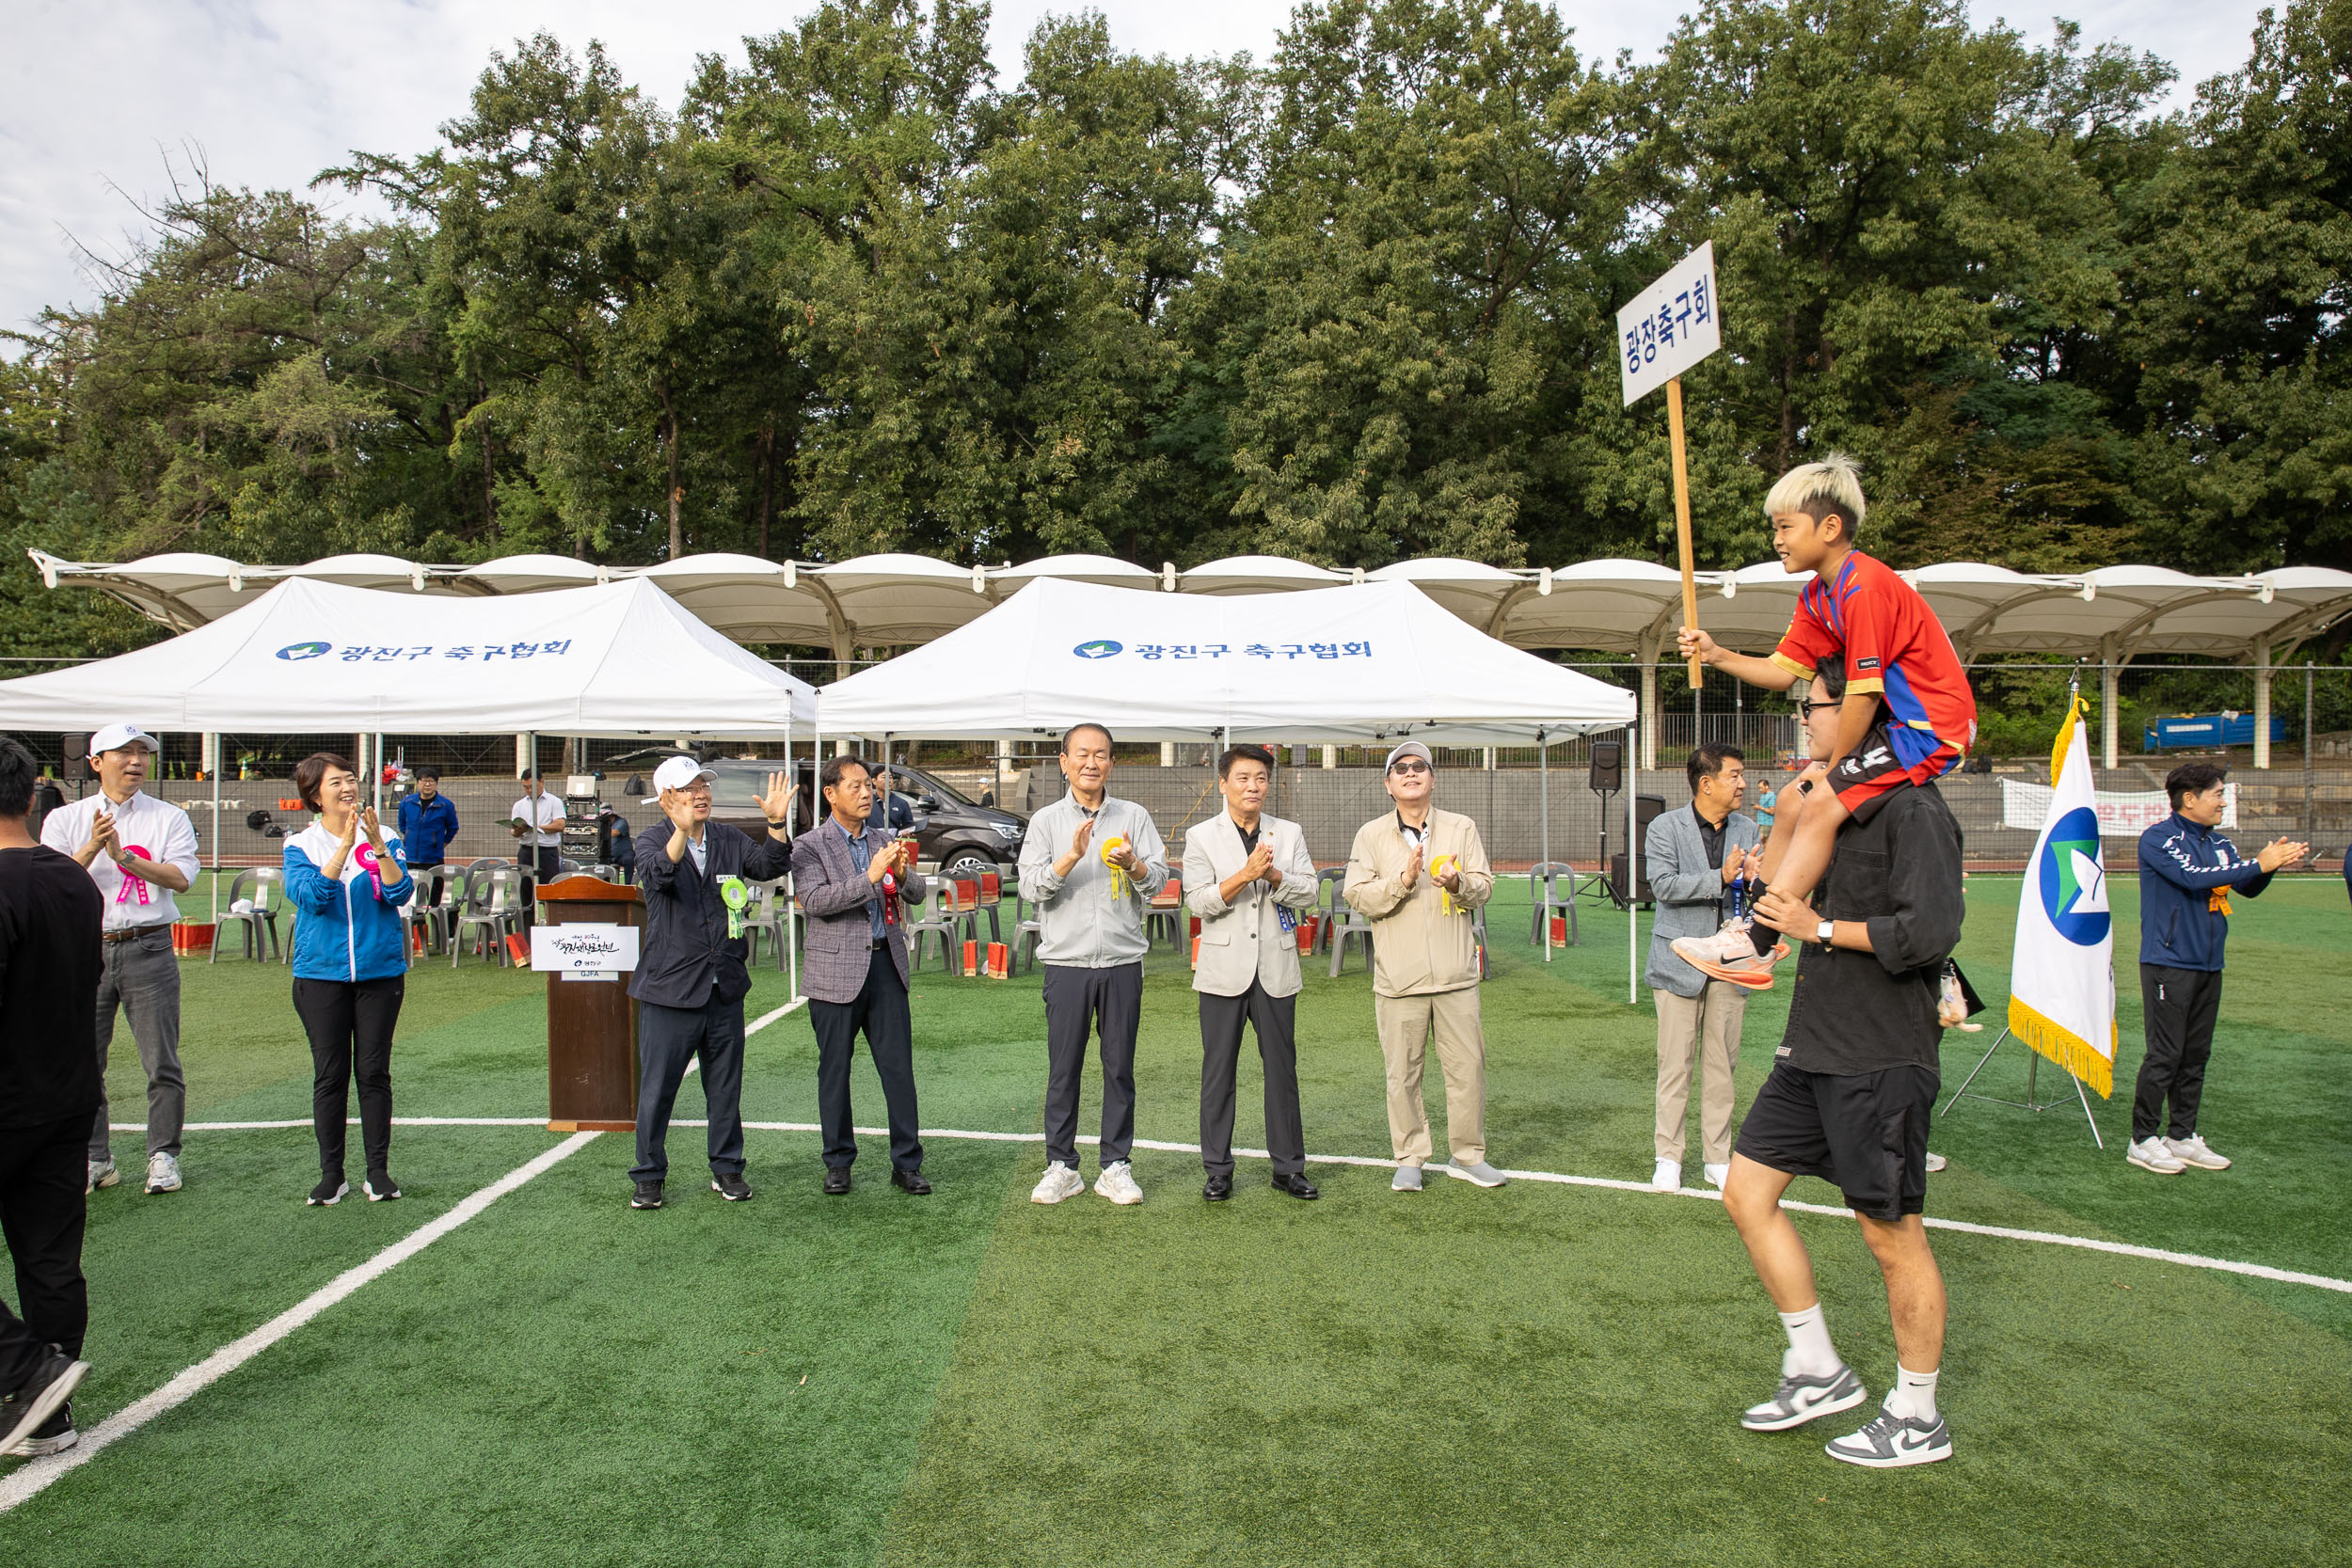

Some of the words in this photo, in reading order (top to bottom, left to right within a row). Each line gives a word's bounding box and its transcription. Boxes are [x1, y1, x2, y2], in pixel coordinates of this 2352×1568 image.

[1626, 274, 1711, 374] 광장축구회
[340, 645, 434, 661] 광진구
[443, 639, 573, 661] 축구협회
[1135, 644, 1232, 659] 광진구
[1243, 641, 1373, 660] 축구협회
